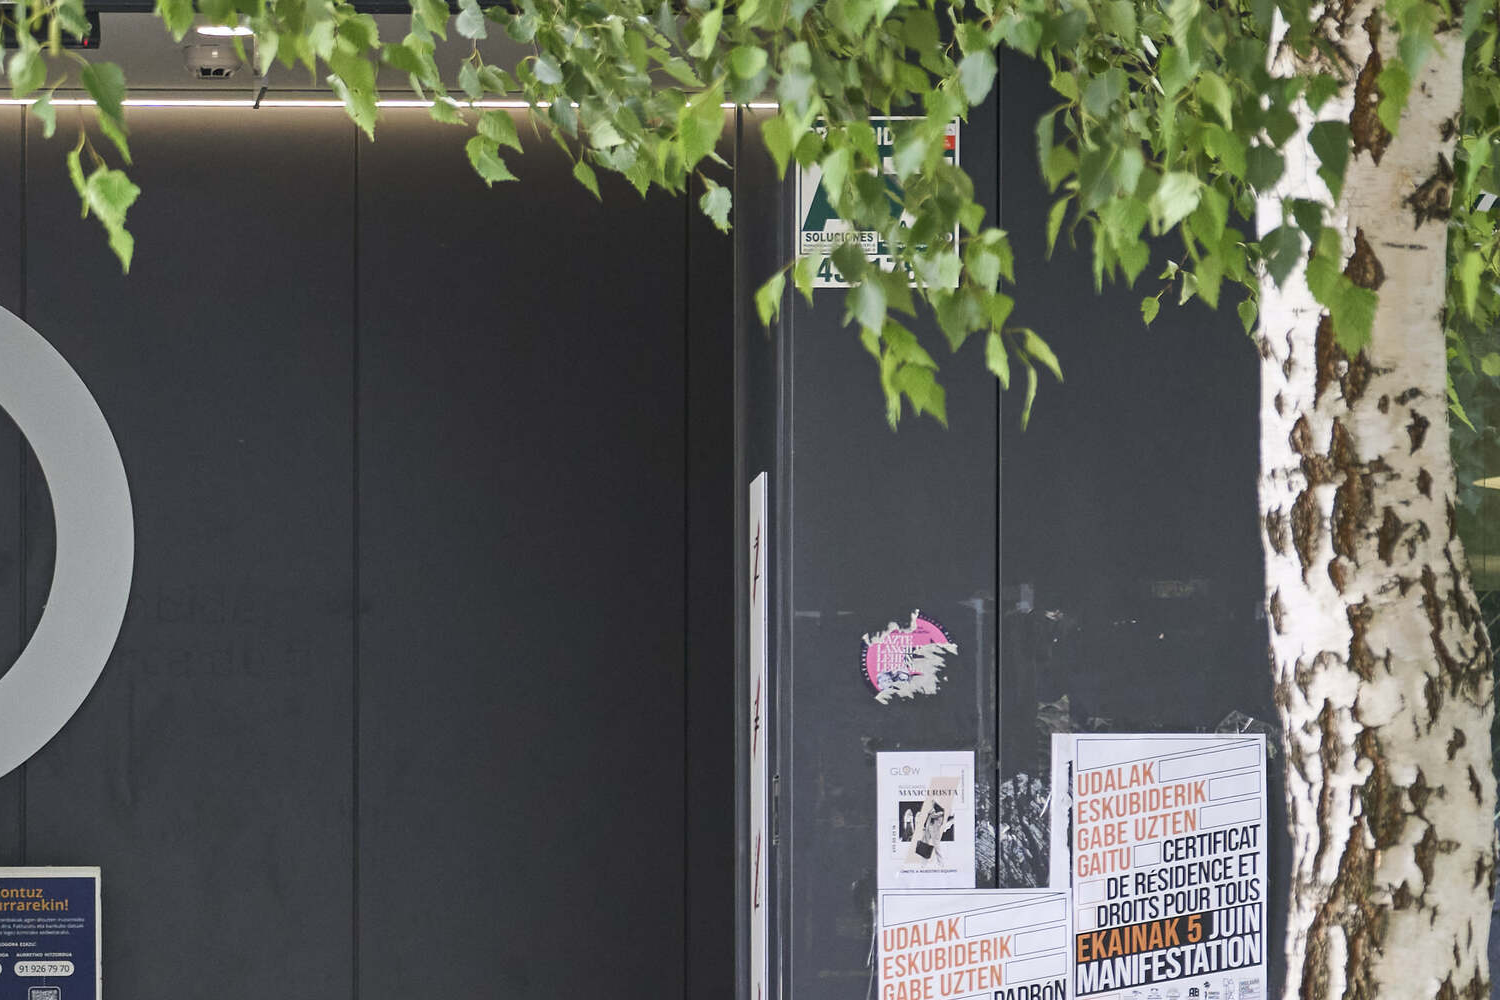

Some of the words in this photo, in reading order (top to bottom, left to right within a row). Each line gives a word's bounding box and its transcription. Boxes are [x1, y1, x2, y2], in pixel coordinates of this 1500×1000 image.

[890, 765, 920, 776] GLOW
[1077, 761, 1155, 797] UDALAK
[899, 789, 958, 797] MANICURISTA
[1077, 779, 1207, 825] ESKUBIDERIK
[1077, 821, 1128, 851] GABE
[1134, 808, 1197, 841] UZTEN
[1077, 846, 1131, 878] GAITU
[1163, 824, 1260, 863] CERTIFICAT
[1107, 875, 1130, 901] DE
[1238, 852, 1260, 877] ET
[1097, 896, 1159, 929] DROITS
[1163, 887, 1211, 918] POUR
[1214, 877, 1260, 907] TOUS
[883, 916, 960, 953] UDALAK
[1077, 917, 1180, 963] EKAINAK
[1188, 915, 1202, 943] 5
[1209, 902, 1261, 940] JUIN
[19, 965, 29, 973] 91
[31, 965, 46, 973] 926
[48, 965, 58, 973] 79
[59, 965, 70, 973] 70
[883, 935, 1012, 980] ESKUBIDERIK
[1077, 933, 1261, 995] MANIFESTATION
[940, 963, 1003, 997] UZTEN
